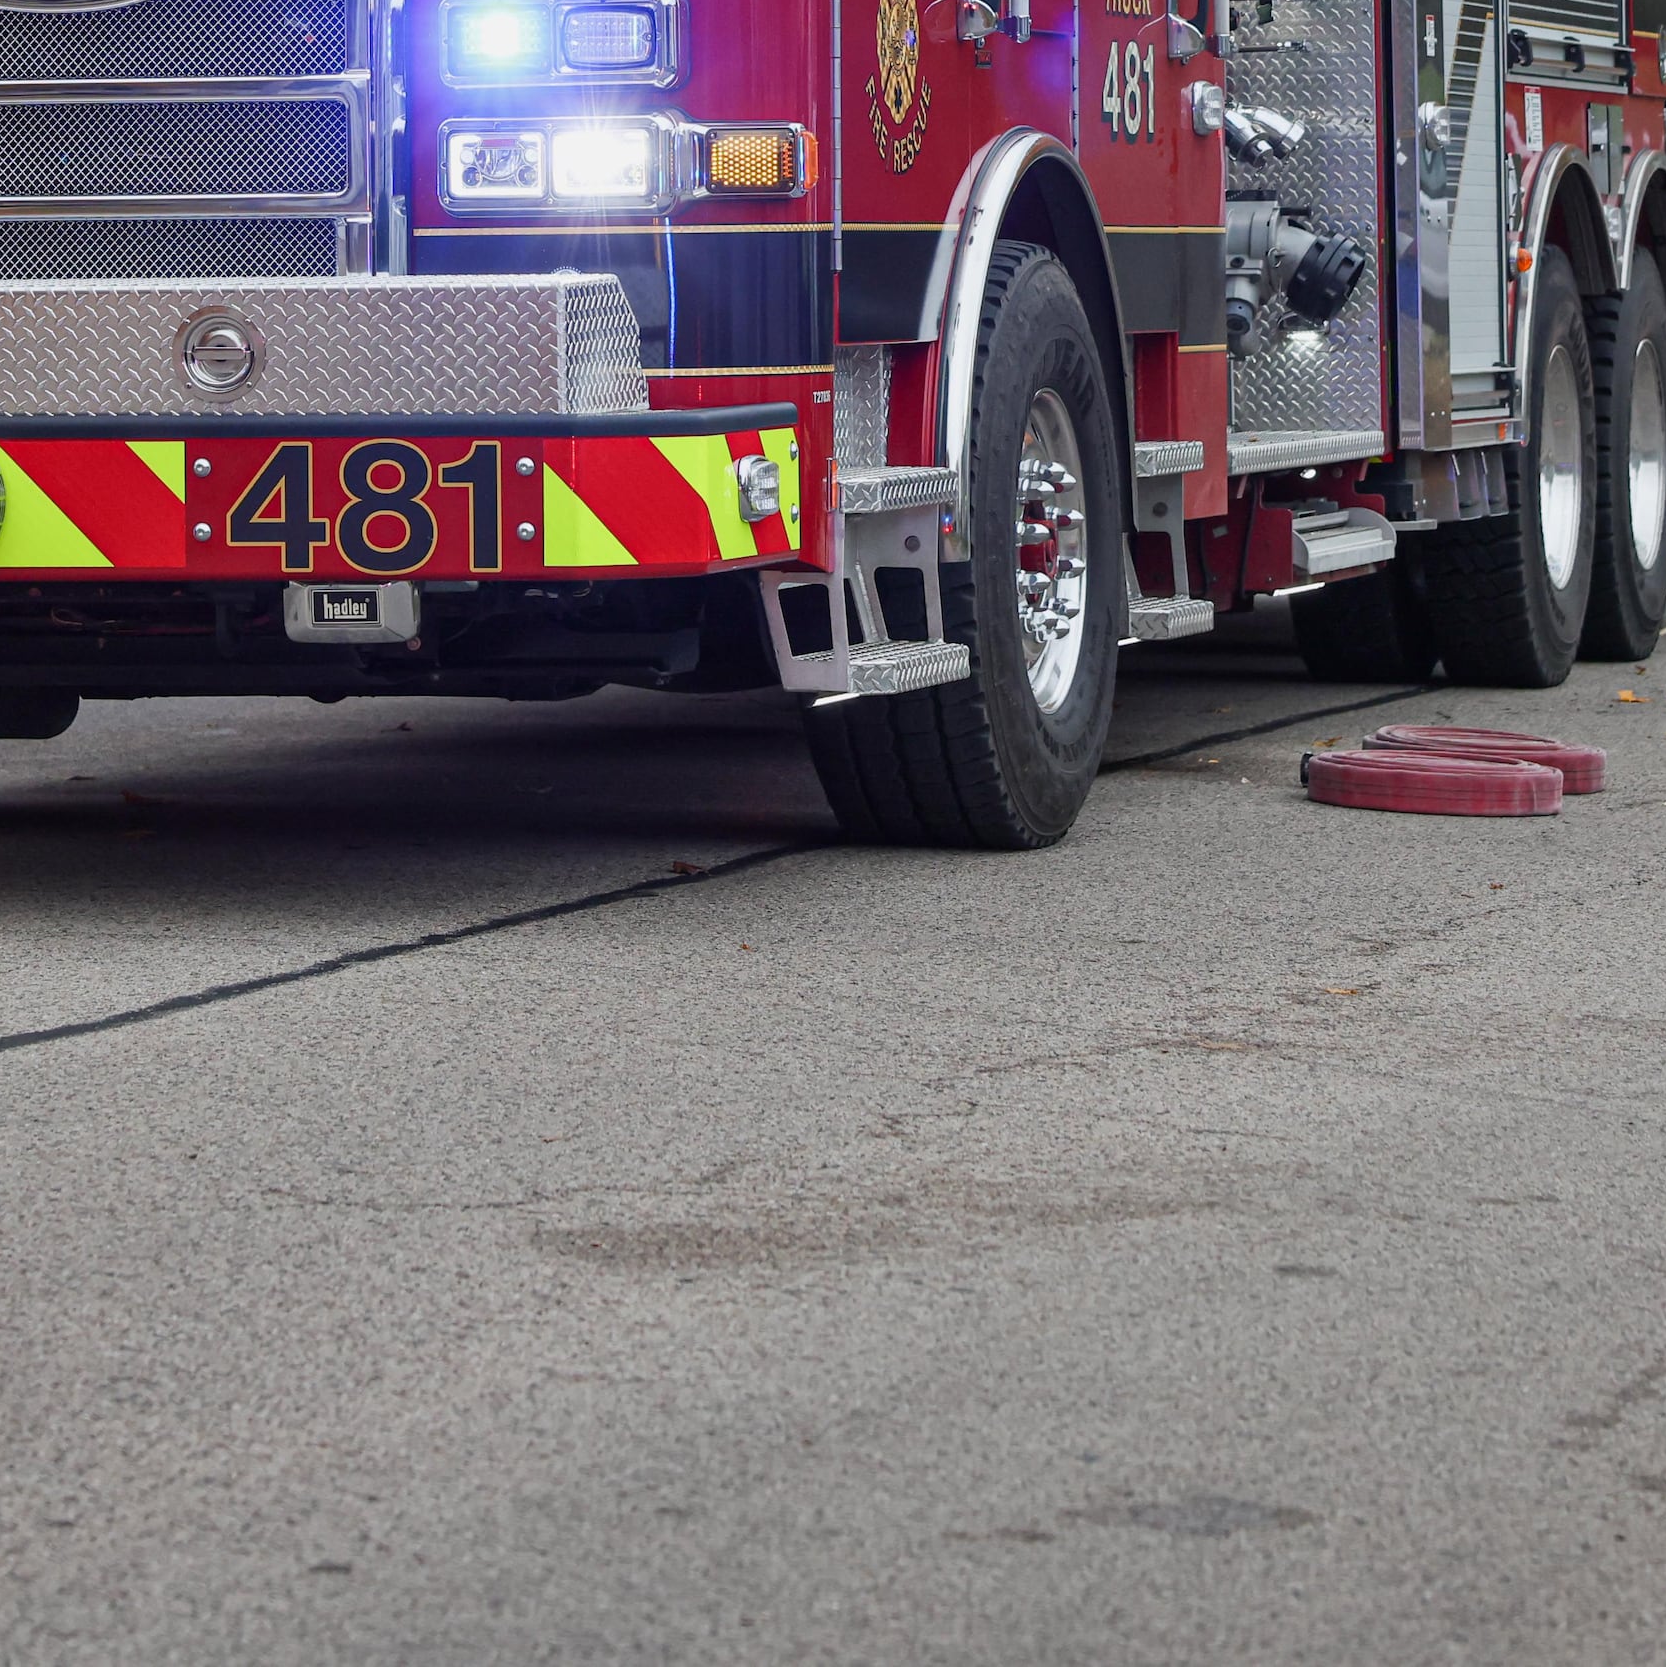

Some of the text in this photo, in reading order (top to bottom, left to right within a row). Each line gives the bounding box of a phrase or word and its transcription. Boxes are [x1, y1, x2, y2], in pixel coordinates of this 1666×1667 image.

[1101, 40, 1155, 143] 481
[225, 437, 503, 575] 481
[323, 594, 368, 620] hadley
